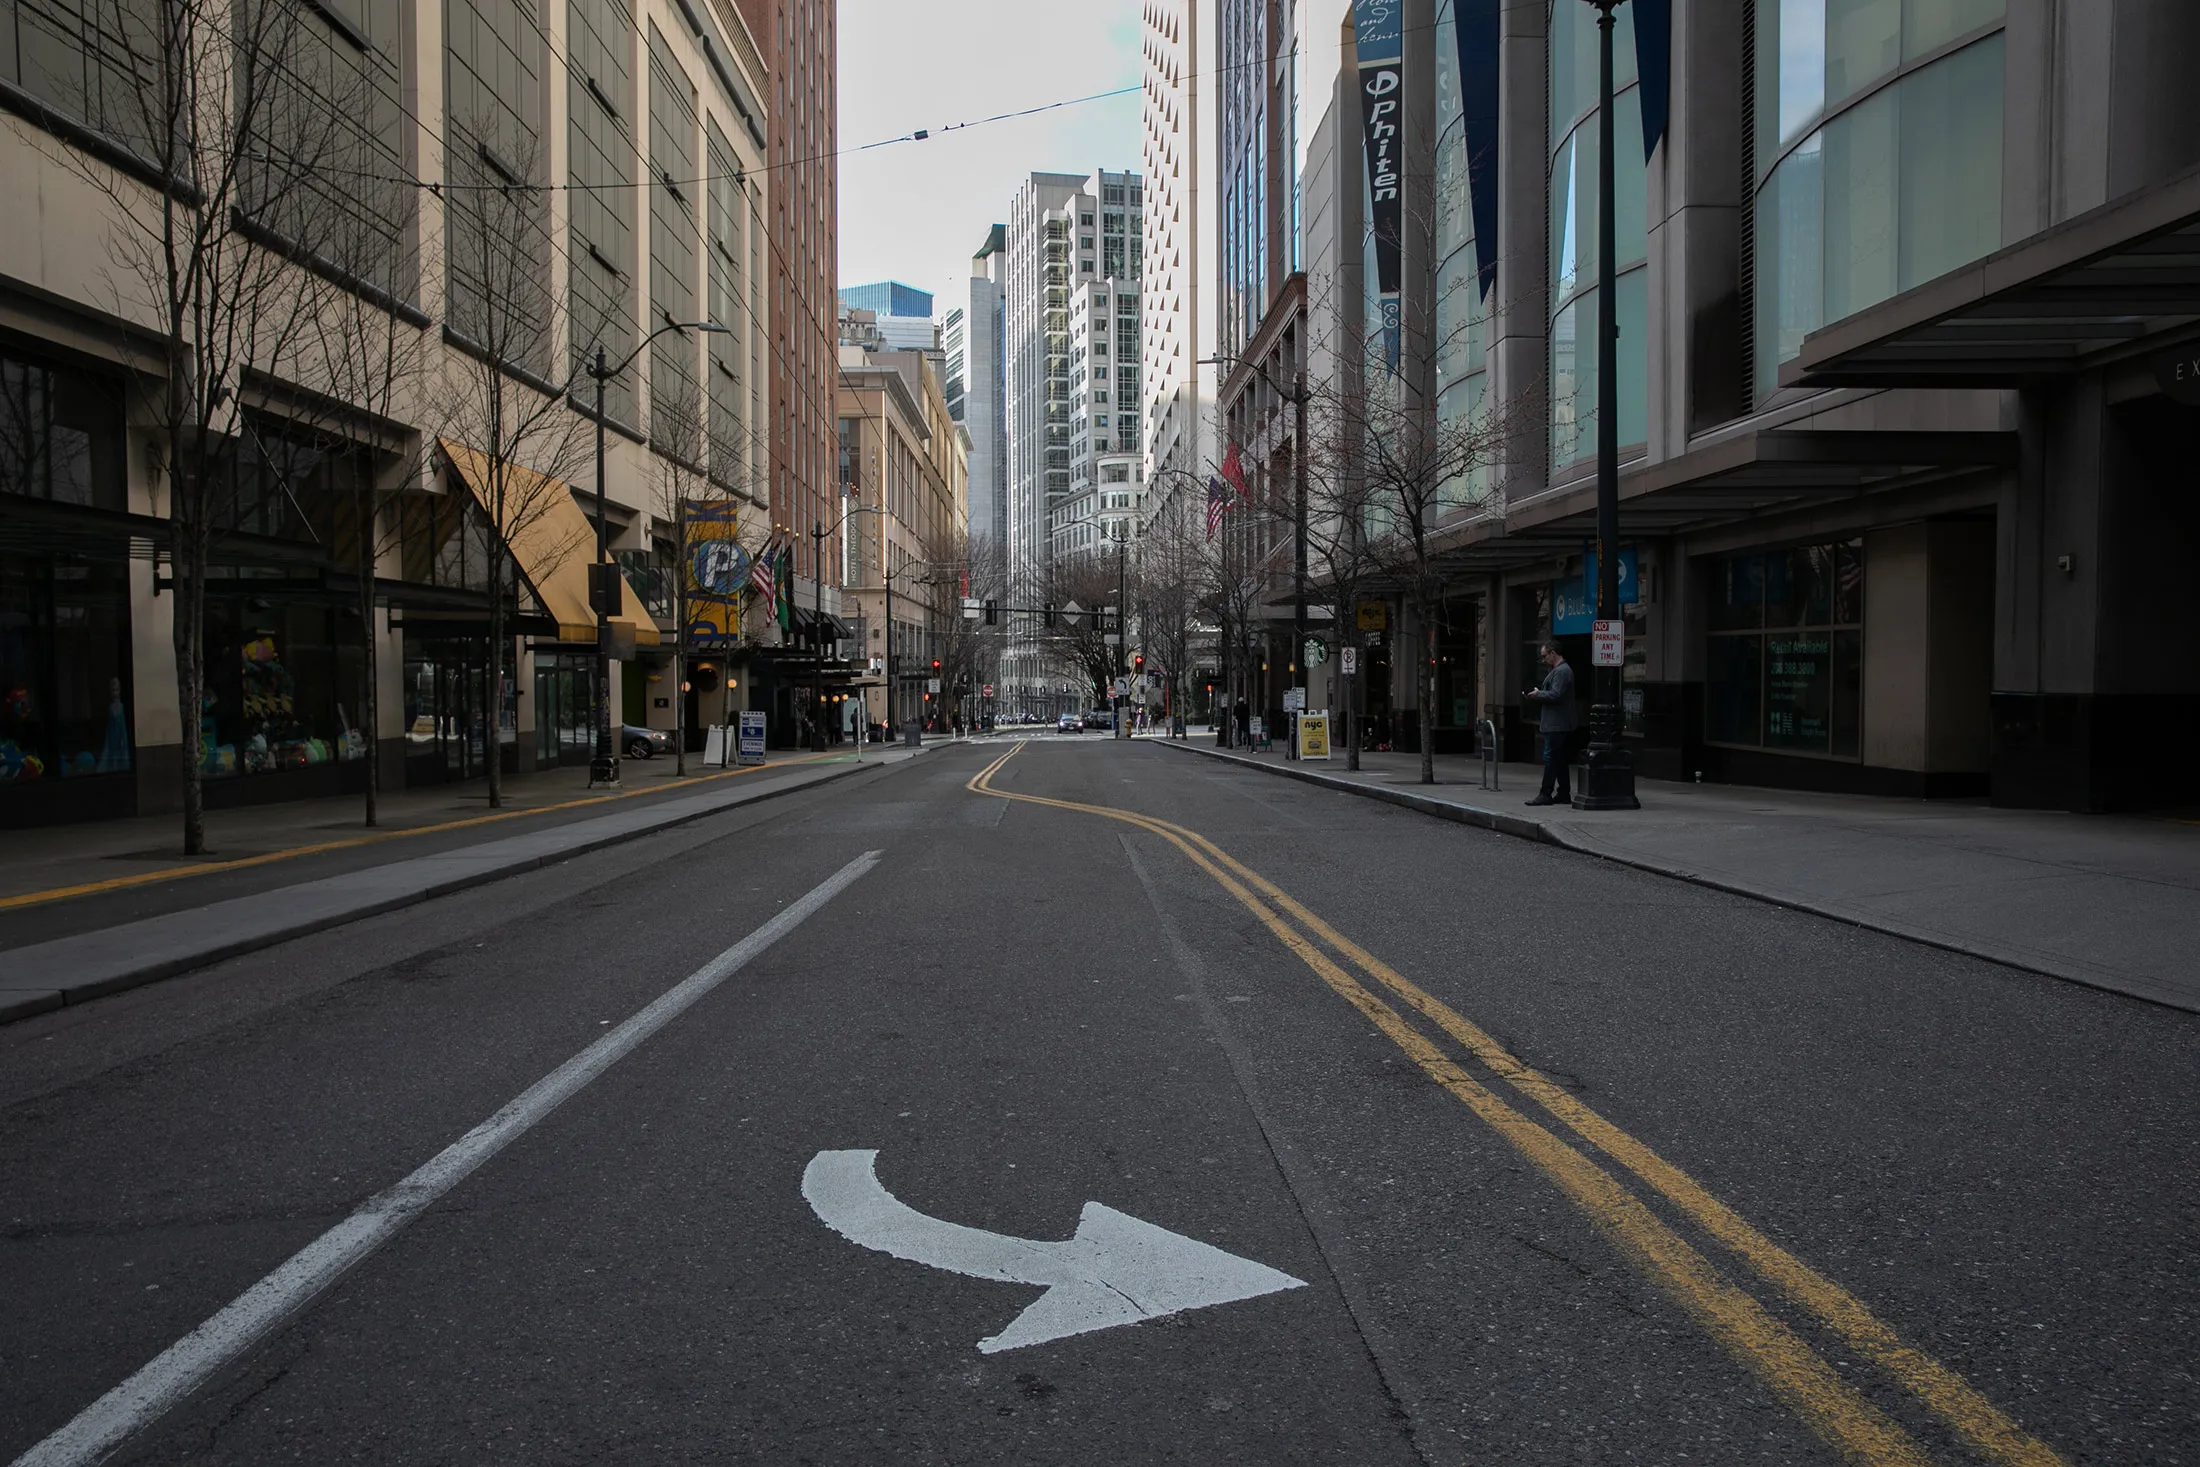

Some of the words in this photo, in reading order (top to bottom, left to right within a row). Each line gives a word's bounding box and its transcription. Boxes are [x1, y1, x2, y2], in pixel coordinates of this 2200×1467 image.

[1360, 7, 1396, 27] and
[1595, 622, 1608, 630] NO
[1595, 633, 1621, 641] PARKING
[1601, 643, 1614, 651] ANY
[1600, 652, 1615, 660] TIME
[1304, 721, 1323, 731] nyc
